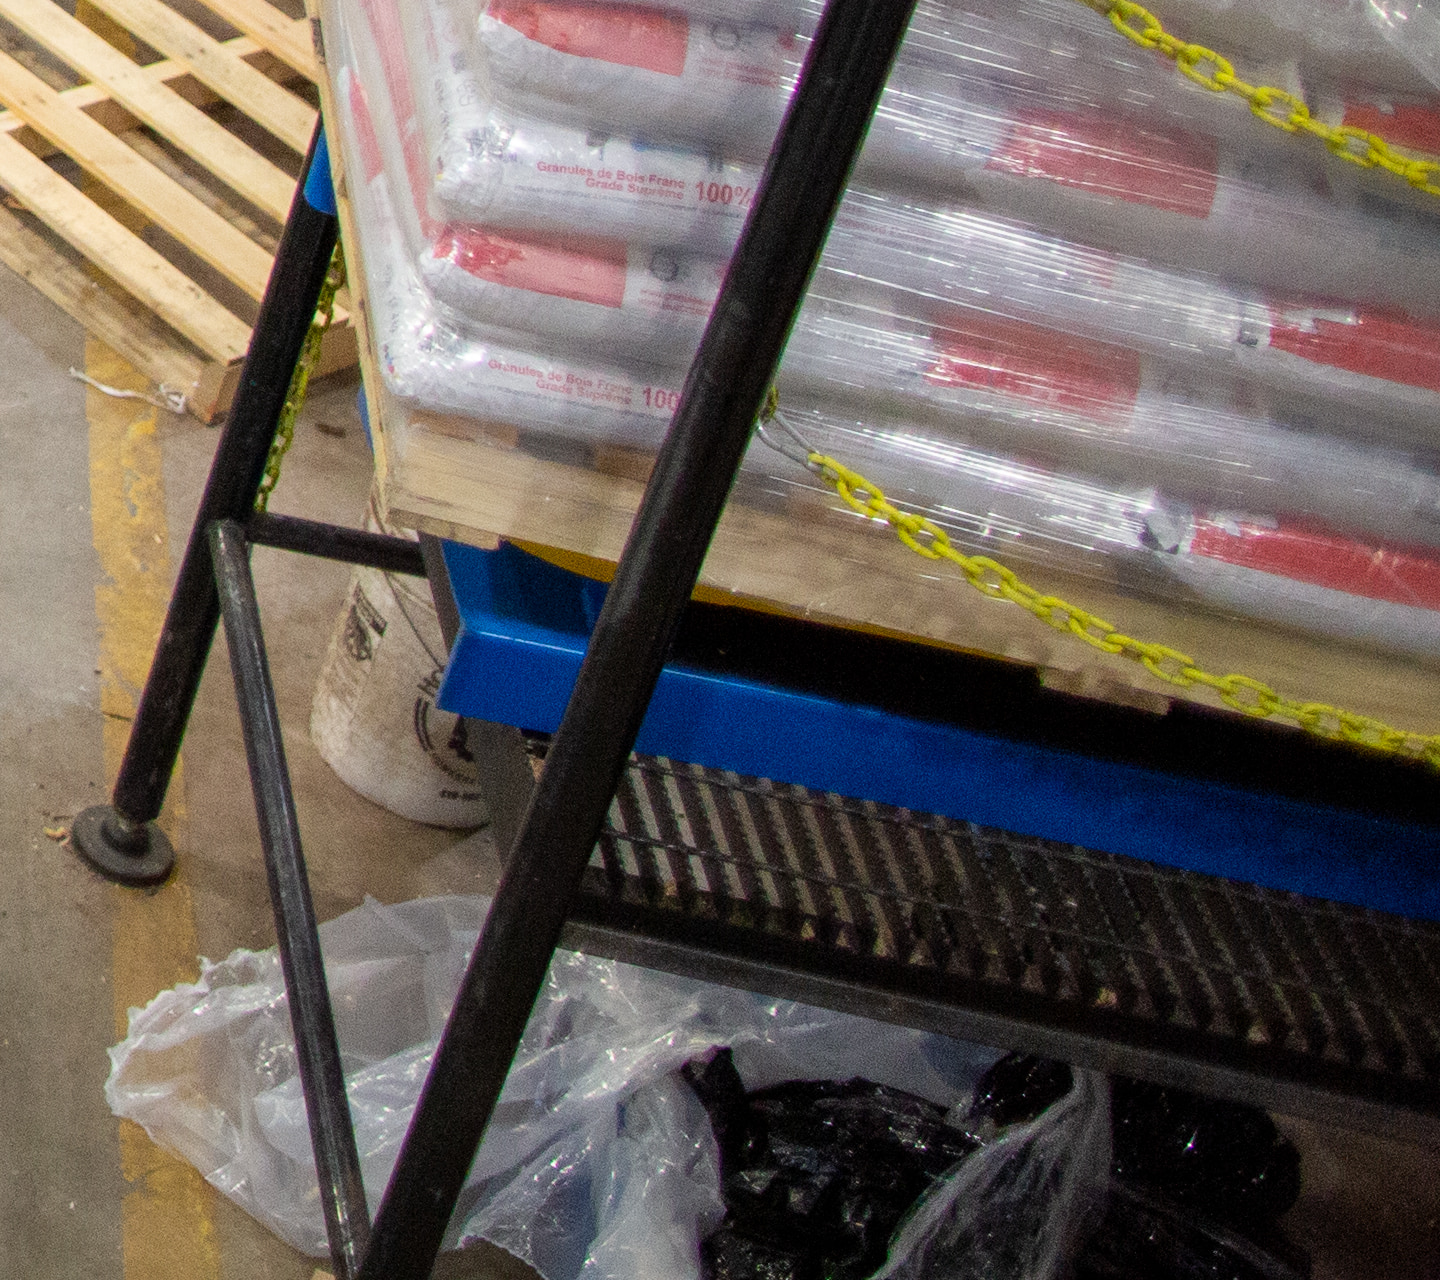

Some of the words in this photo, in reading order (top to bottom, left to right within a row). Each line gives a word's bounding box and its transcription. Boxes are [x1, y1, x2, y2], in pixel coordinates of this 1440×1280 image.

[537, 160, 593, 178] Granules
[596, 167, 612, 180] de
[616, 169, 647, 184] Bois
[649, 173, 686, 188] Franc
[585, 176, 624, 192] Grade
